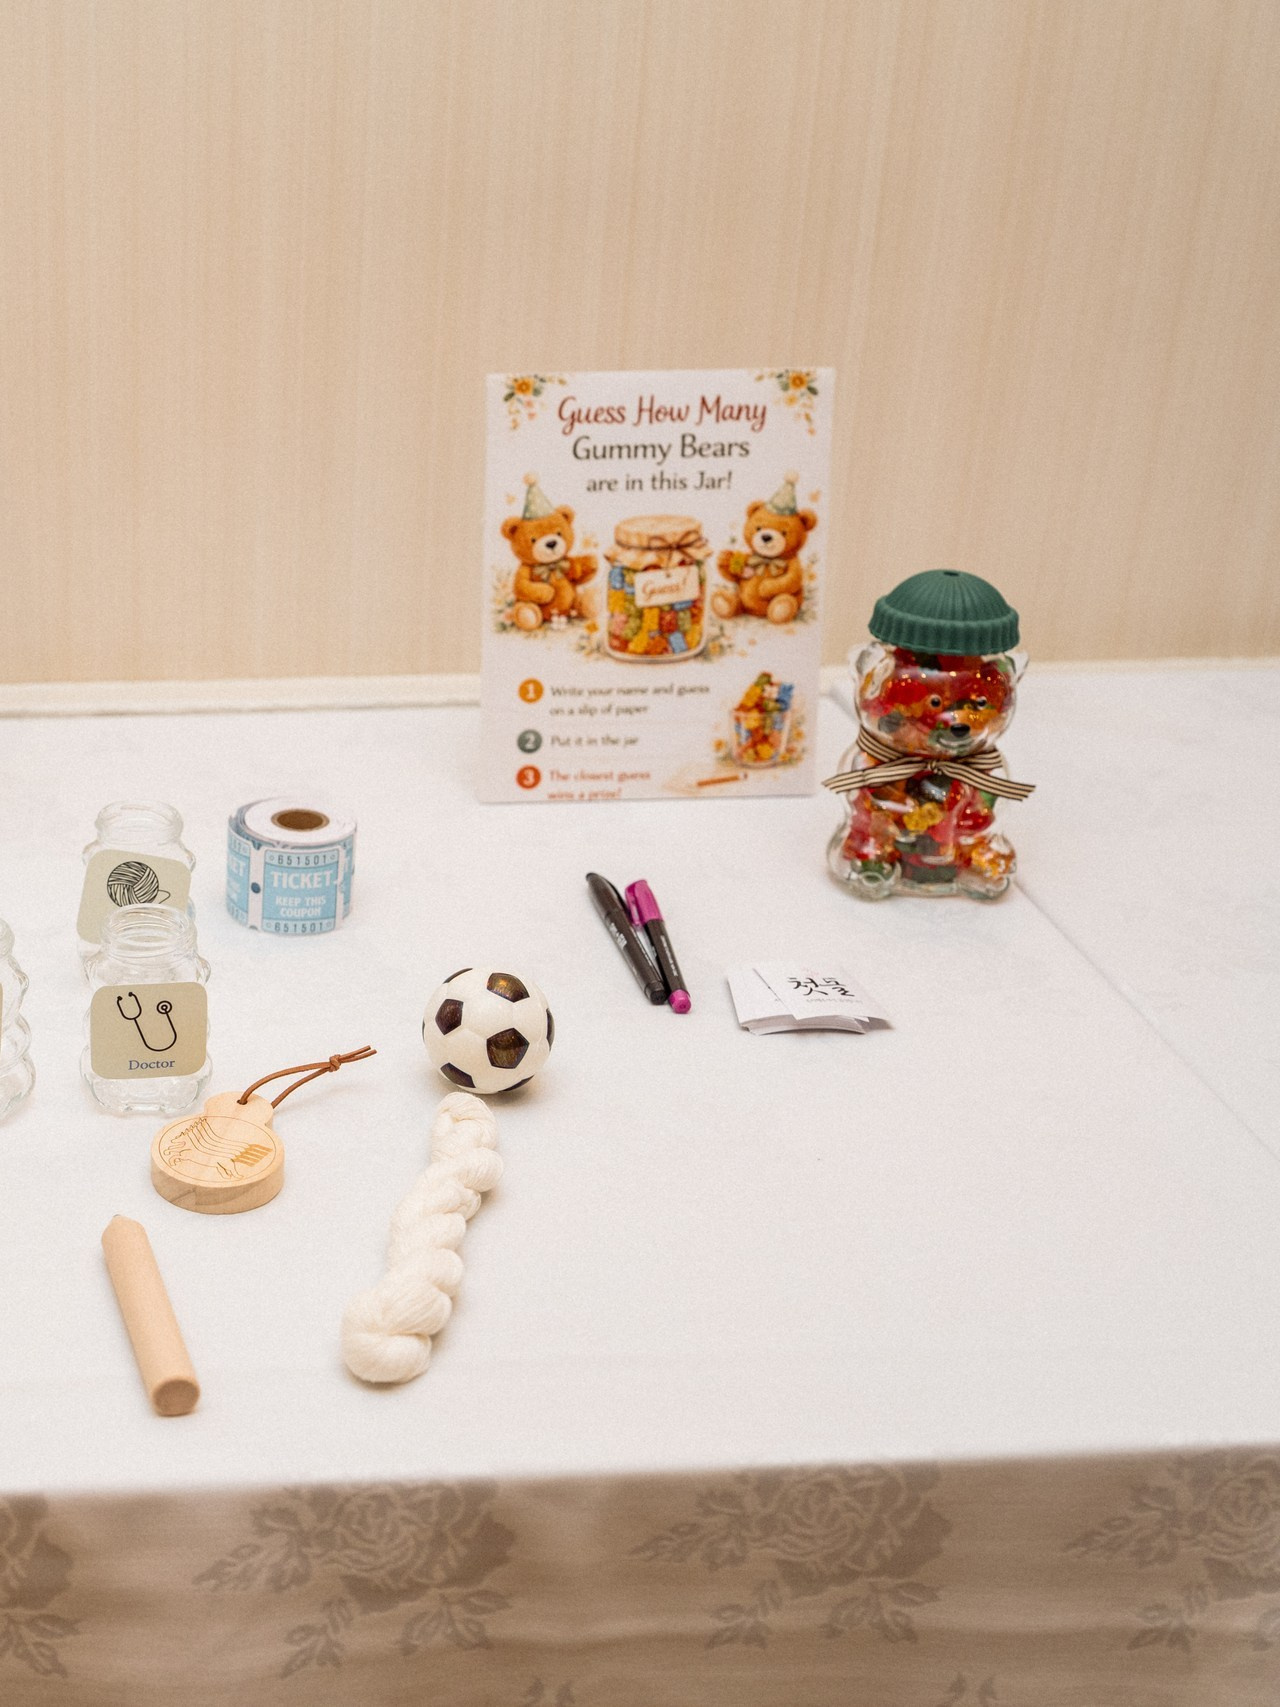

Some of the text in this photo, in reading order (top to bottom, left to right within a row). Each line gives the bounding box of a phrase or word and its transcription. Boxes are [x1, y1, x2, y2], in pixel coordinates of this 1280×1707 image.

[558, 394, 768, 436] Guess How Many
[573, 432, 750, 466] Gummy Bears
[586, 470, 733, 493] are in this Jar!
[550, 686, 583, 697] Write
[587, 687, 613, 697] your
[617, 686, 648, 696] name
[652, 683, 674, 694] and
[677, 685, 710, 697] guess
[549, 707, 565, 716] on
[579, 704, 596, 717] slip
[600, 703, 613, 715] of
[616, 705, 648, 717] paper
[524, 733, 537, 749] 2
[550, 735, 570, 747] Put
[587, 735, 597, 746] in
[601, 734, 619, 746] the
[623, 735, 639, 748] jar
[523, 769, 651, 785] 3 The closest guess
[277, 854, 328, 866] 651501
[270, 869, 334, 889] TICKET
[276, 895, 327, 907] KEEP THIS
[279, 906, 322, 918] COUPON
[274, 921, 324, 934] 651501
[128, 1058, 176, 1071] Doctor
